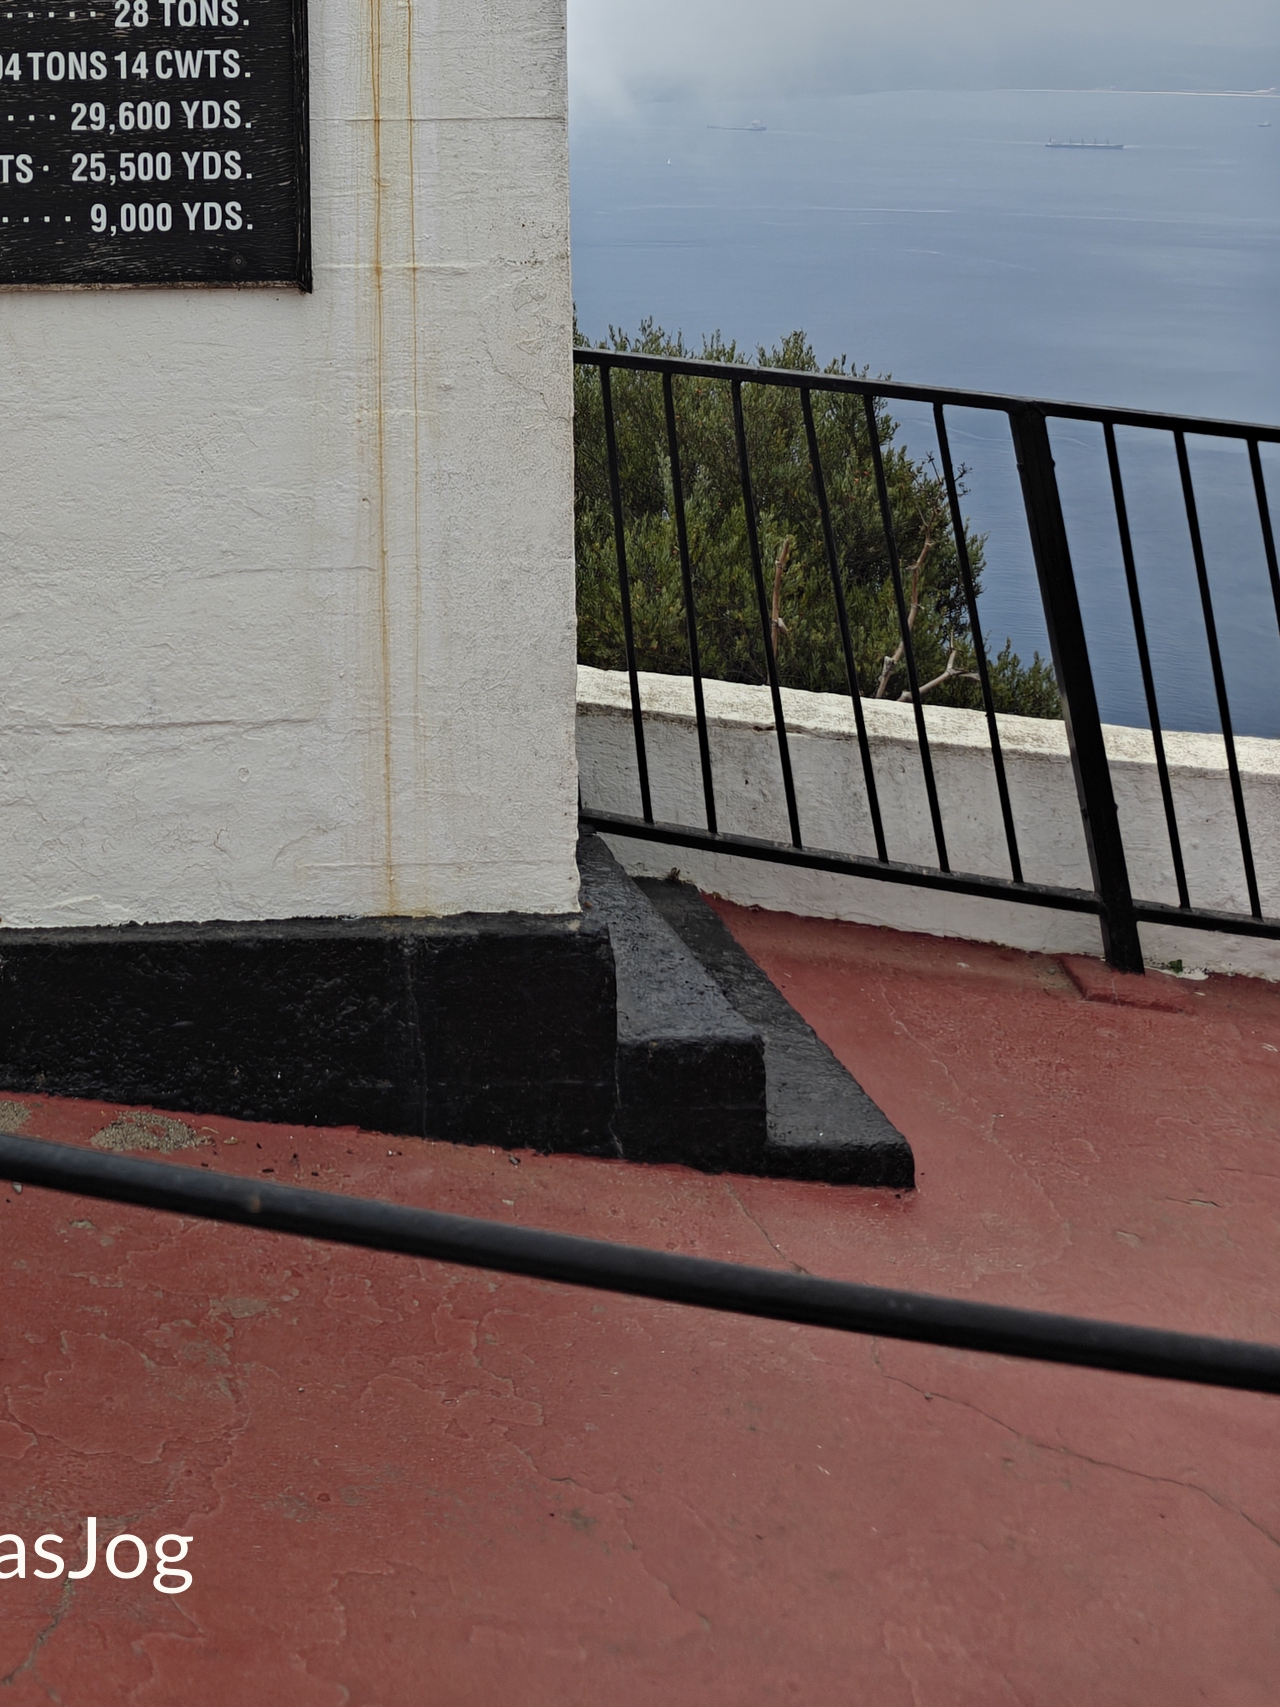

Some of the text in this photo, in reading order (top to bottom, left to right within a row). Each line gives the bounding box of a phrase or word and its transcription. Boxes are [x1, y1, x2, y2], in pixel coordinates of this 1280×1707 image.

[26, 50, 107, 81] TONS
[114, 51, 149, 79] 14
[155, 49, 251, 79] CWTS.
[71, 101, 171, 135] 29,600
[180, 99, 252, 129] YDS.
[71, 151, 171, 186] 25,500
[181, 150, 253, 180] YDS.
[90, 202, 172, 237] 9,000
[182, 201, 253, 231] YDS.
